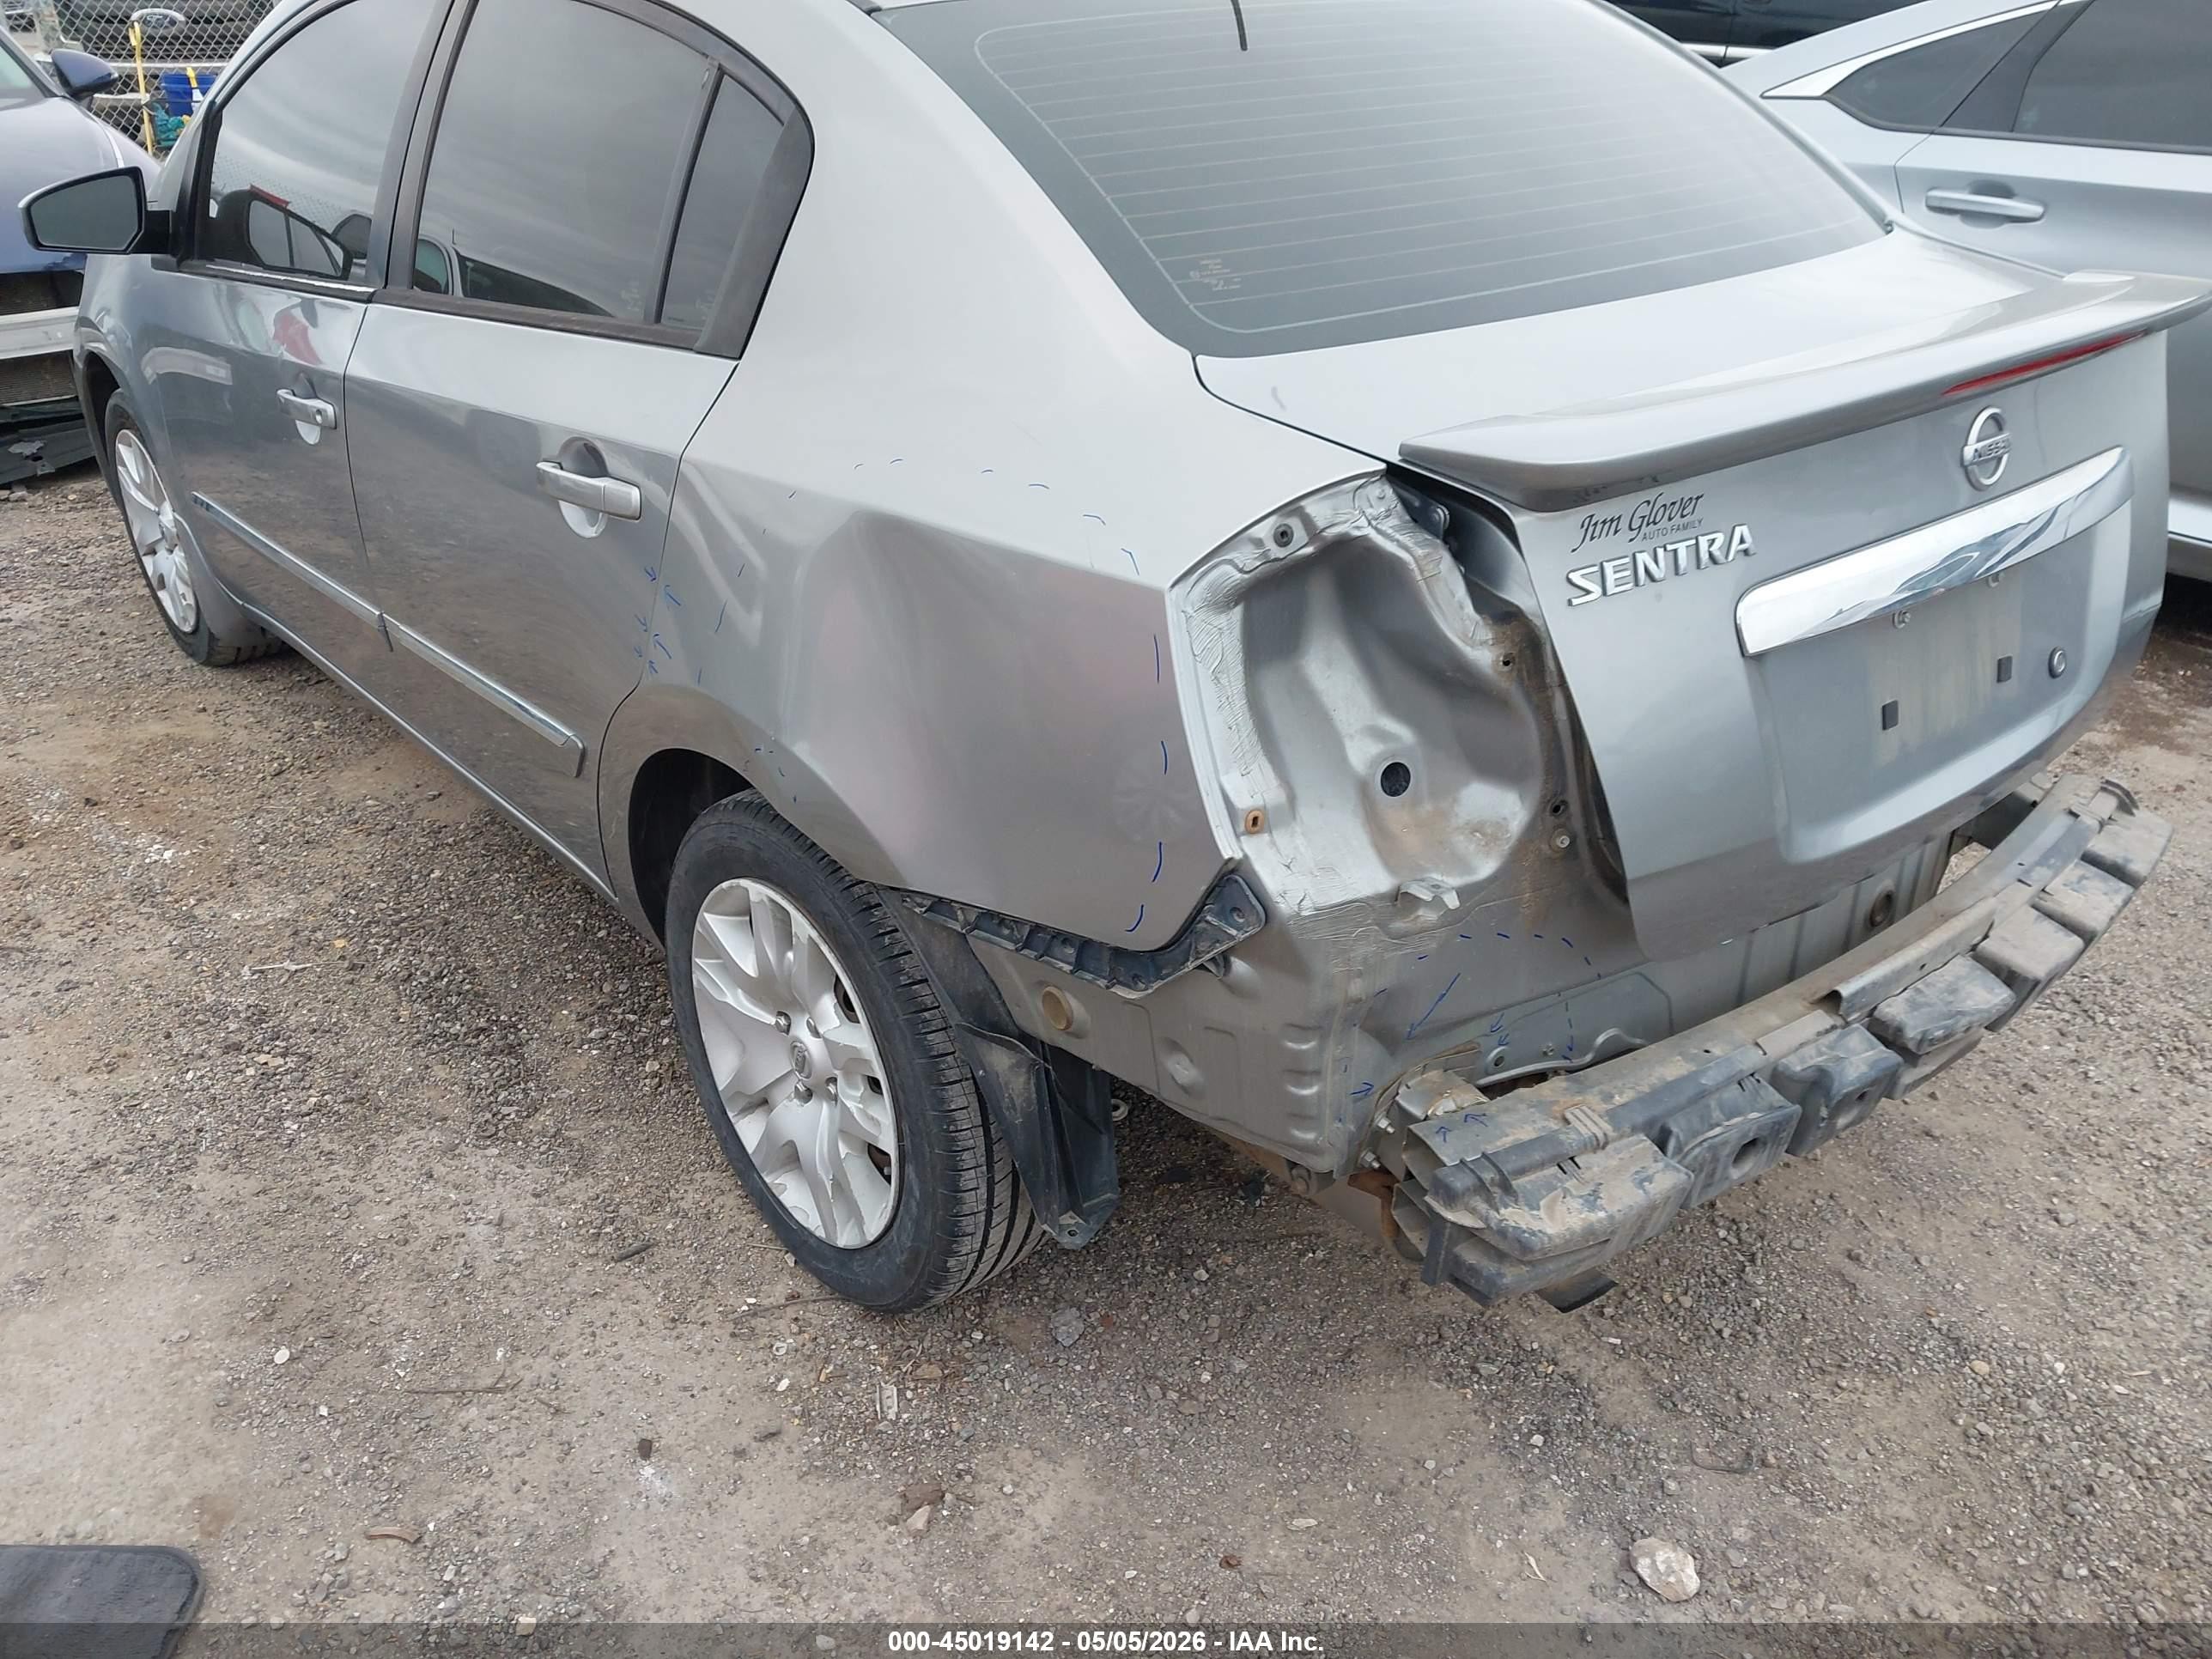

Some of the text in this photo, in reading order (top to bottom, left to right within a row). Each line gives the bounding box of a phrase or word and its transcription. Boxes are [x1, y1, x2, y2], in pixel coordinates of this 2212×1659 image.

[1571, 492, 1705, 553] Jim Glover
[1642, 517, 1705, 542] AUTO FAMILY
[1566, 523, 1757, 606] SENTRA
